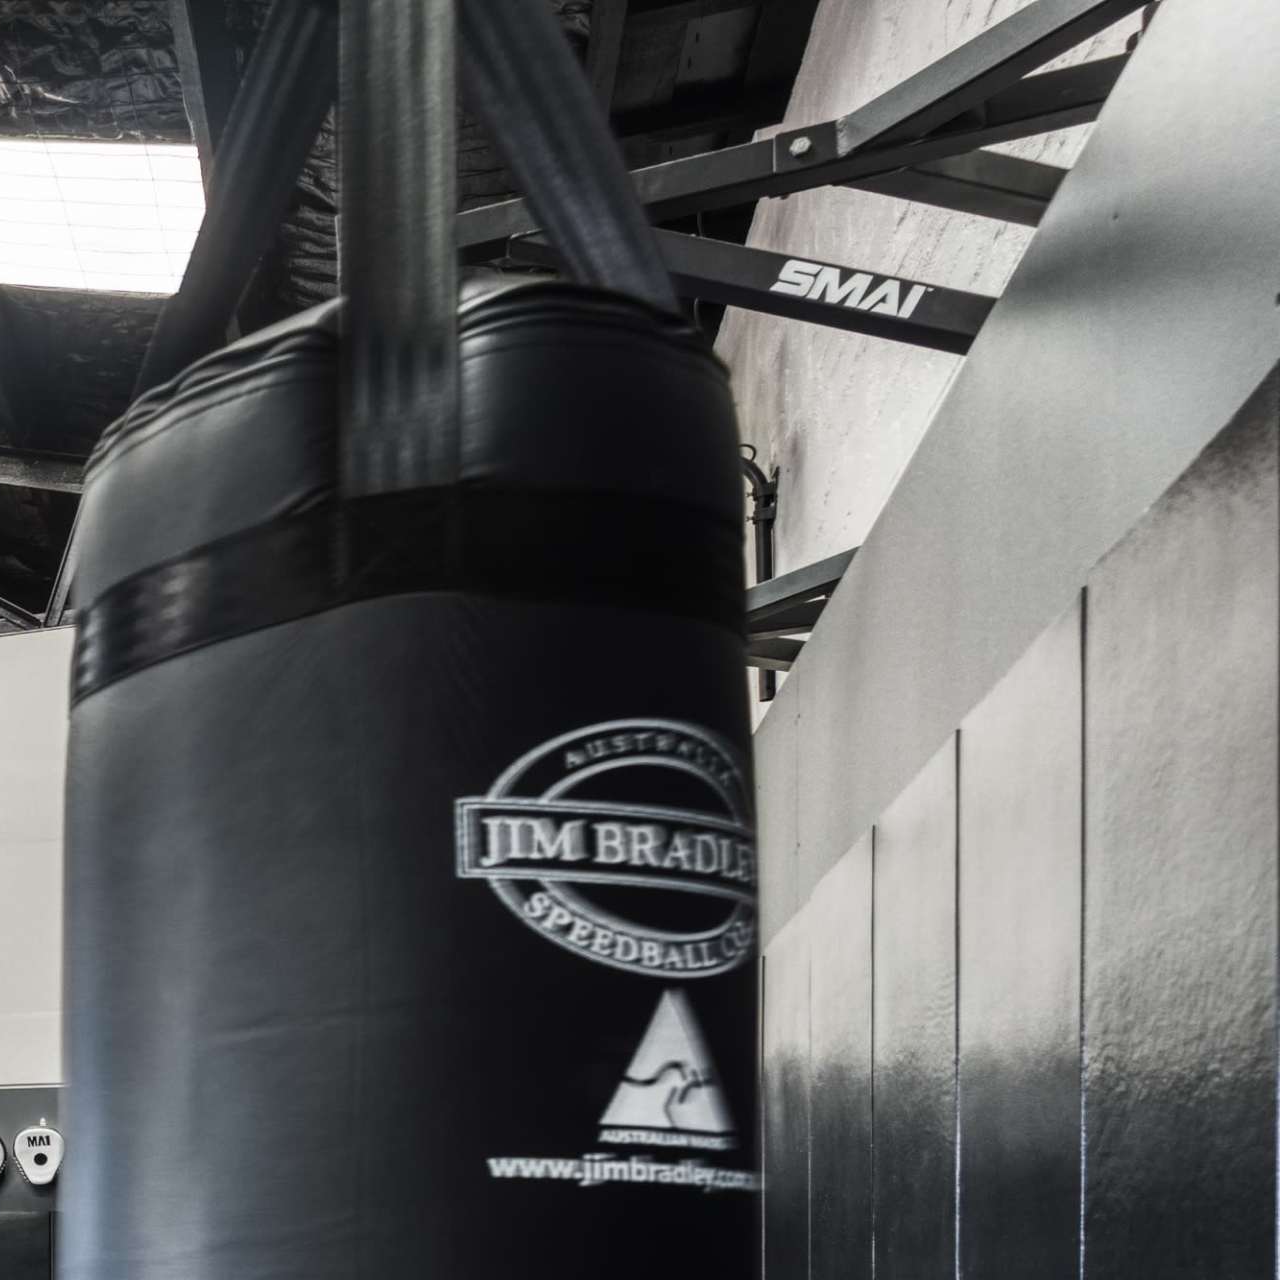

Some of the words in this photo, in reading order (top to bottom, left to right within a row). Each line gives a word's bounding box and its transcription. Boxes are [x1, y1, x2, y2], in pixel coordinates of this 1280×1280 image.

[769, 259, 928, 319] SMAI
[480, 815, 587, 866] JIM
[593, 822, 756, 882] BRADLE
[524, 892, 717, 969] SPEEDBALL
